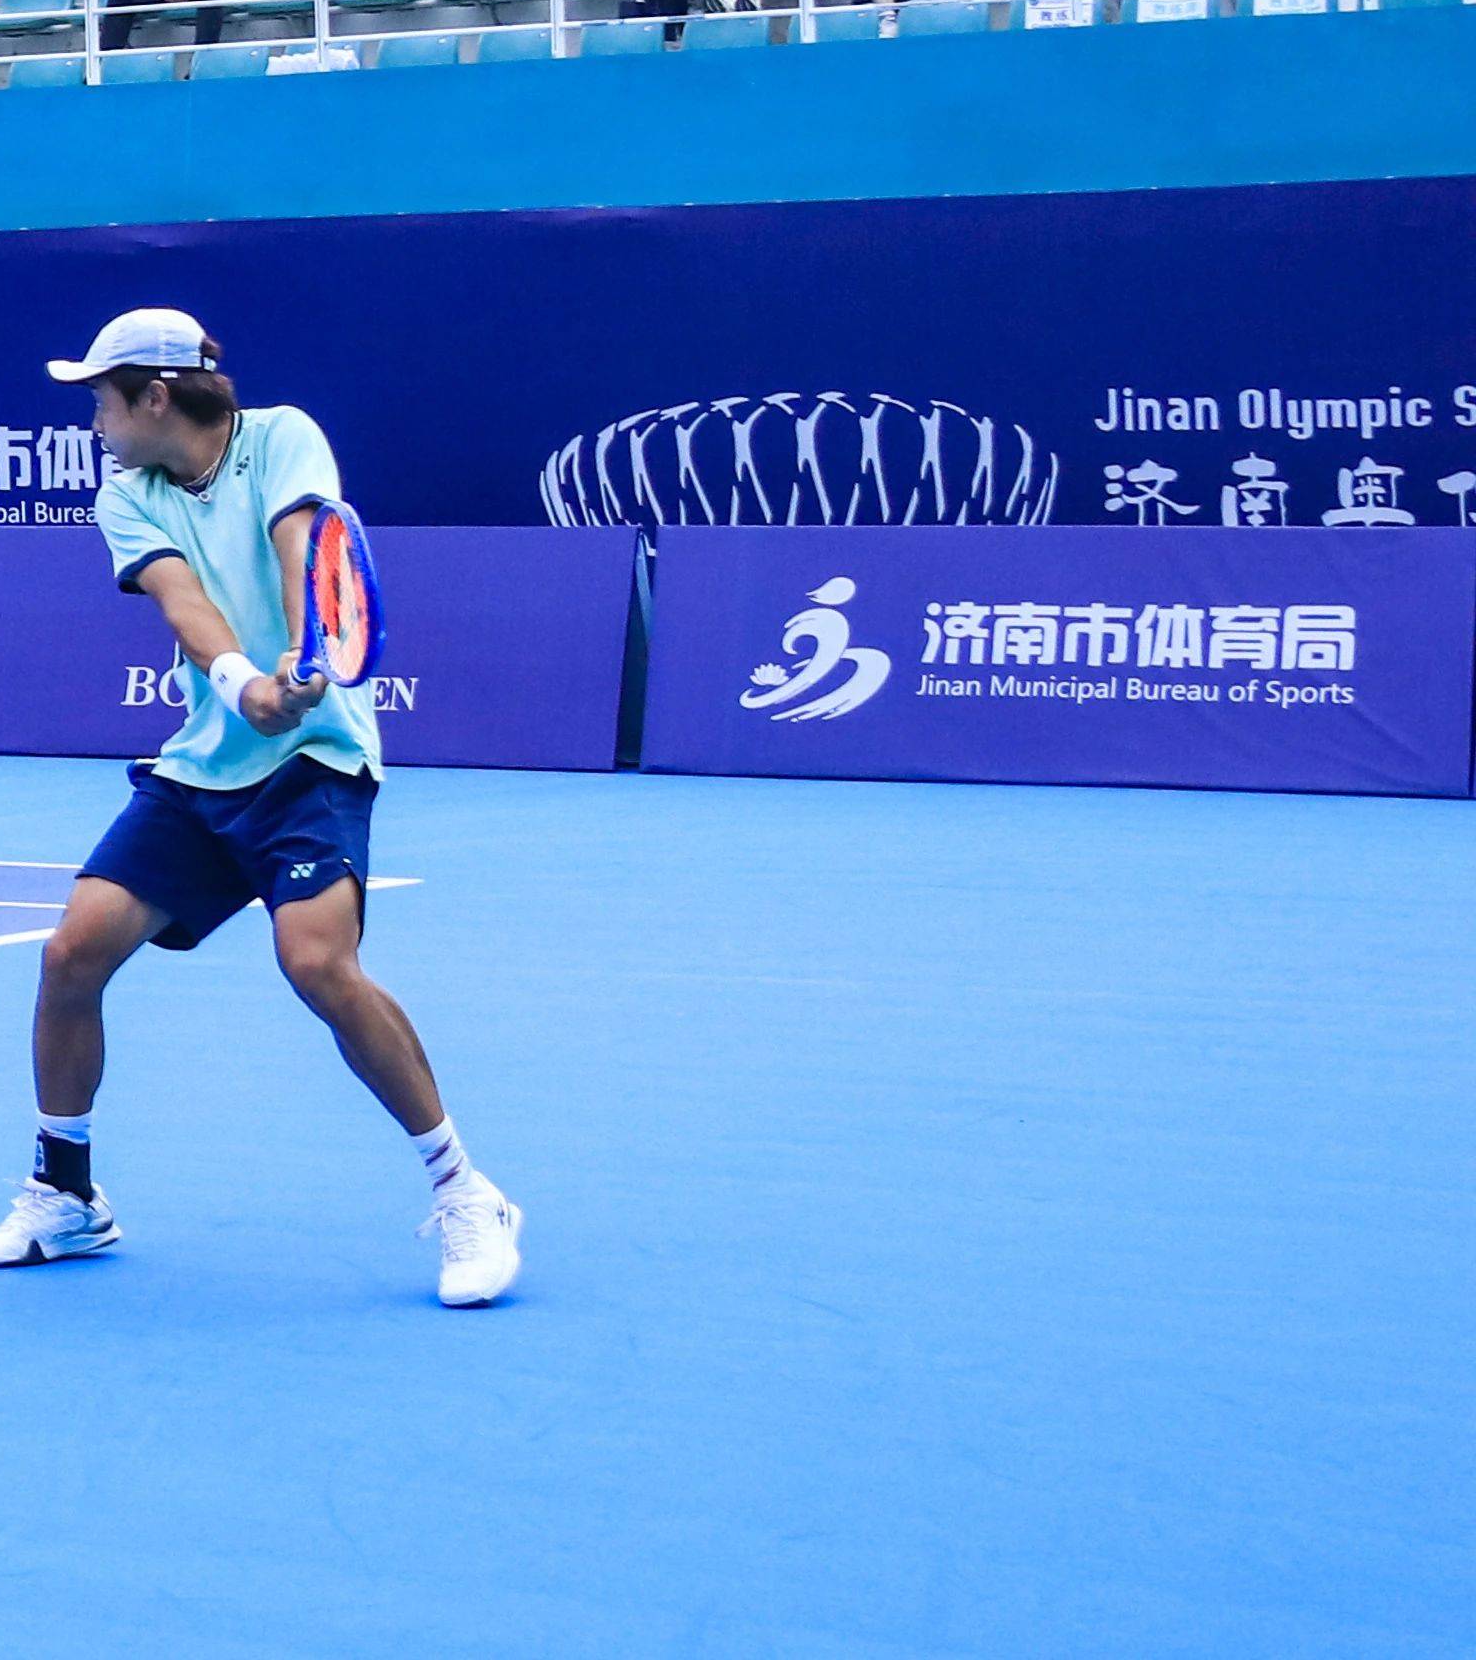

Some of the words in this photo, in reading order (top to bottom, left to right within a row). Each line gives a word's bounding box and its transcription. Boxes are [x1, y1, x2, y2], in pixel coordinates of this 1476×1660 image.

[1094, 387, 1220, 432] Jinan
[1238, 387, 1433, 440] Olympic
[34, 501, 98, 524] Burea
[921, 601, 1357, 672] 济南市体育局
[916, 674, 981, 698] Jinan
[989, 675, 1118, 706] Municipal
[1125, 678, 1220, 703] Bureau
[1228, 680, 1258, 703] of
[1261, 680, 1355, 710] Sports
